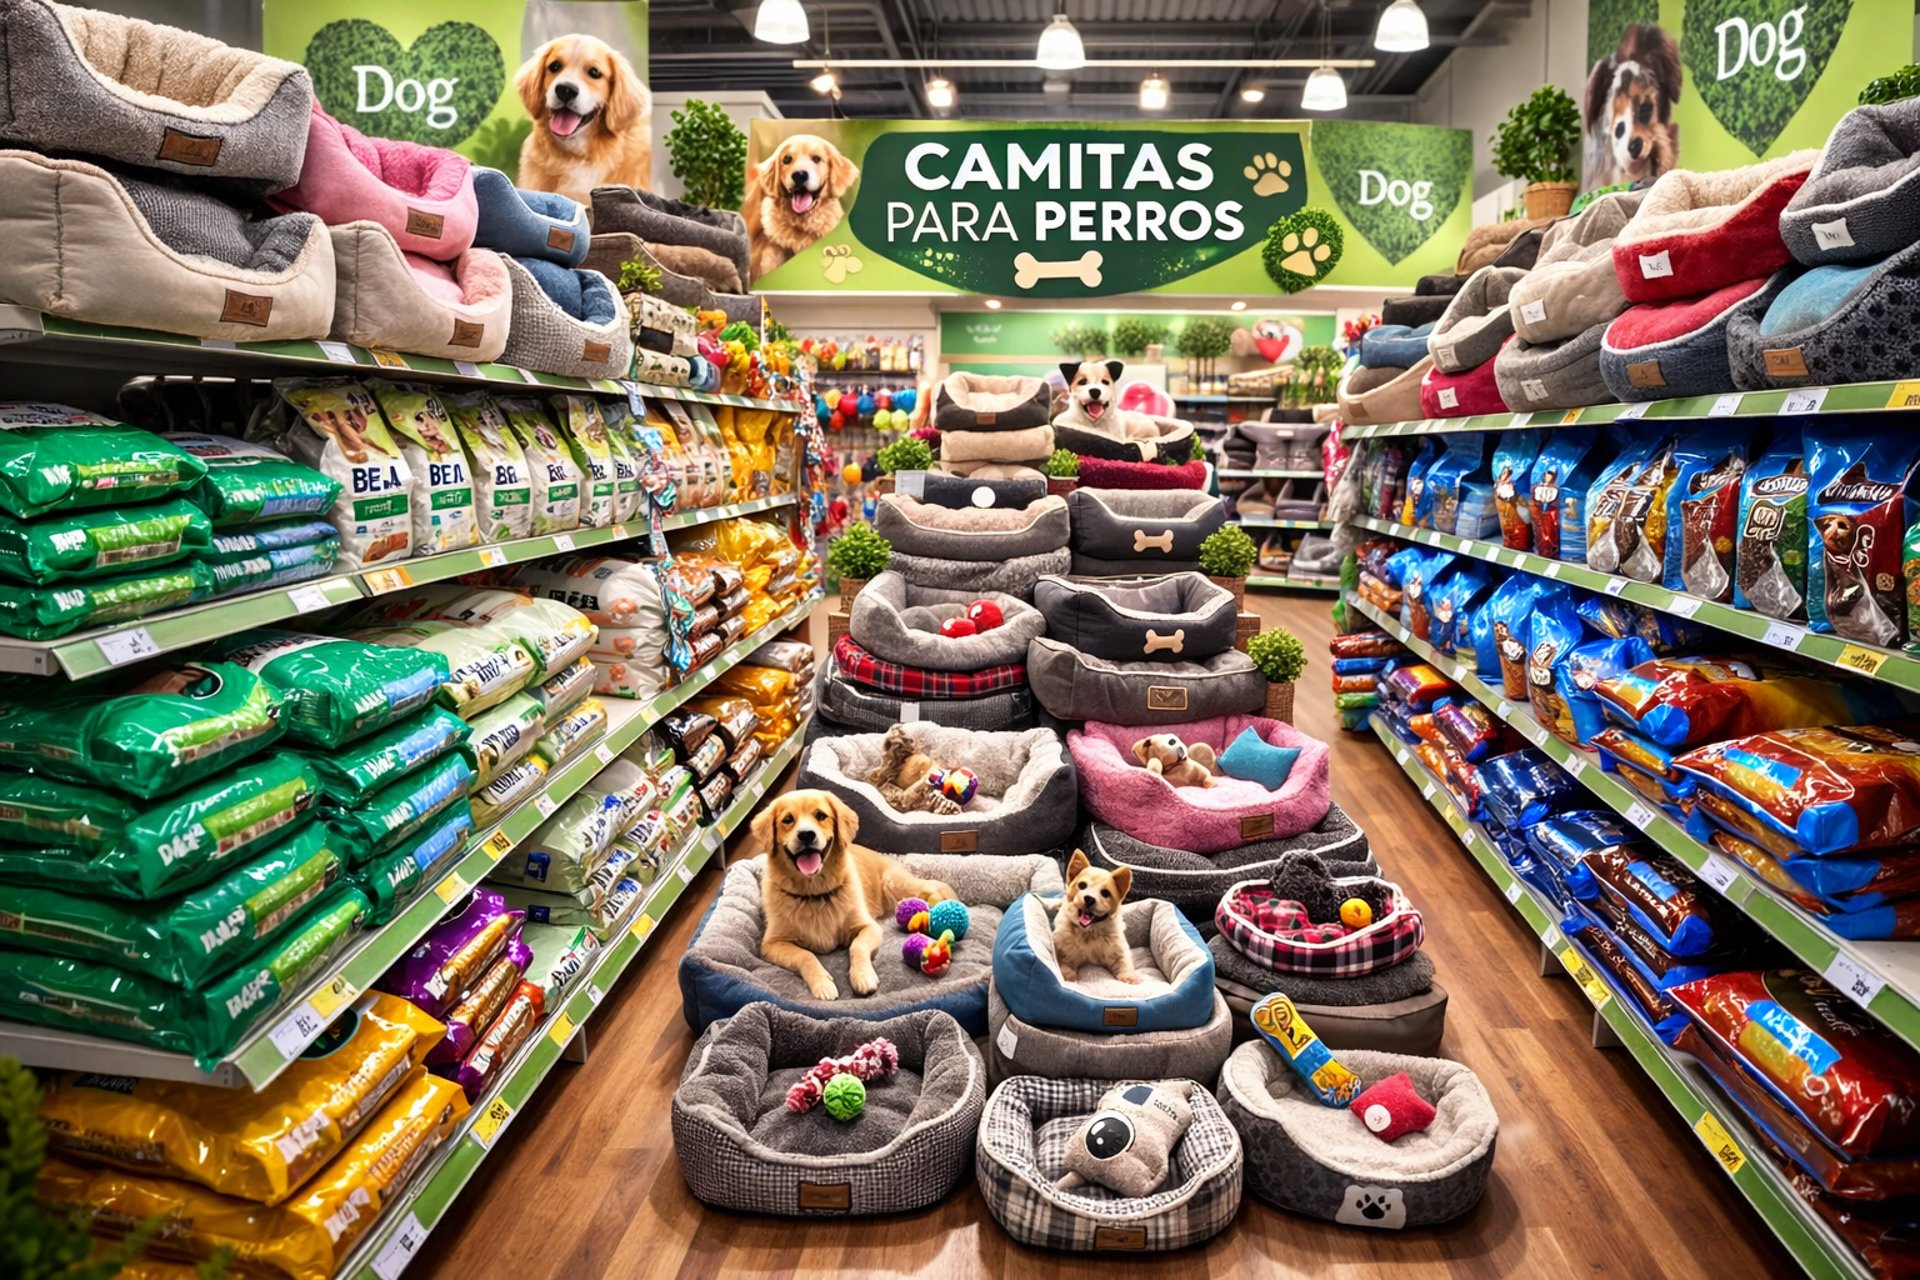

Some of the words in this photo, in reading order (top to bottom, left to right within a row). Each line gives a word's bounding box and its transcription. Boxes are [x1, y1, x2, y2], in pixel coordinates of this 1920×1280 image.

[1713, 6, 1808, 82] Dog
[352, 64, 460, 130] Dog
[904, 142, 1214, 191] CAMITAS
[1357, 169, 1434, 221] Dog
[887, 201, 1019, 243] PARA
[1035, 200, 1245, 242] PERROS
